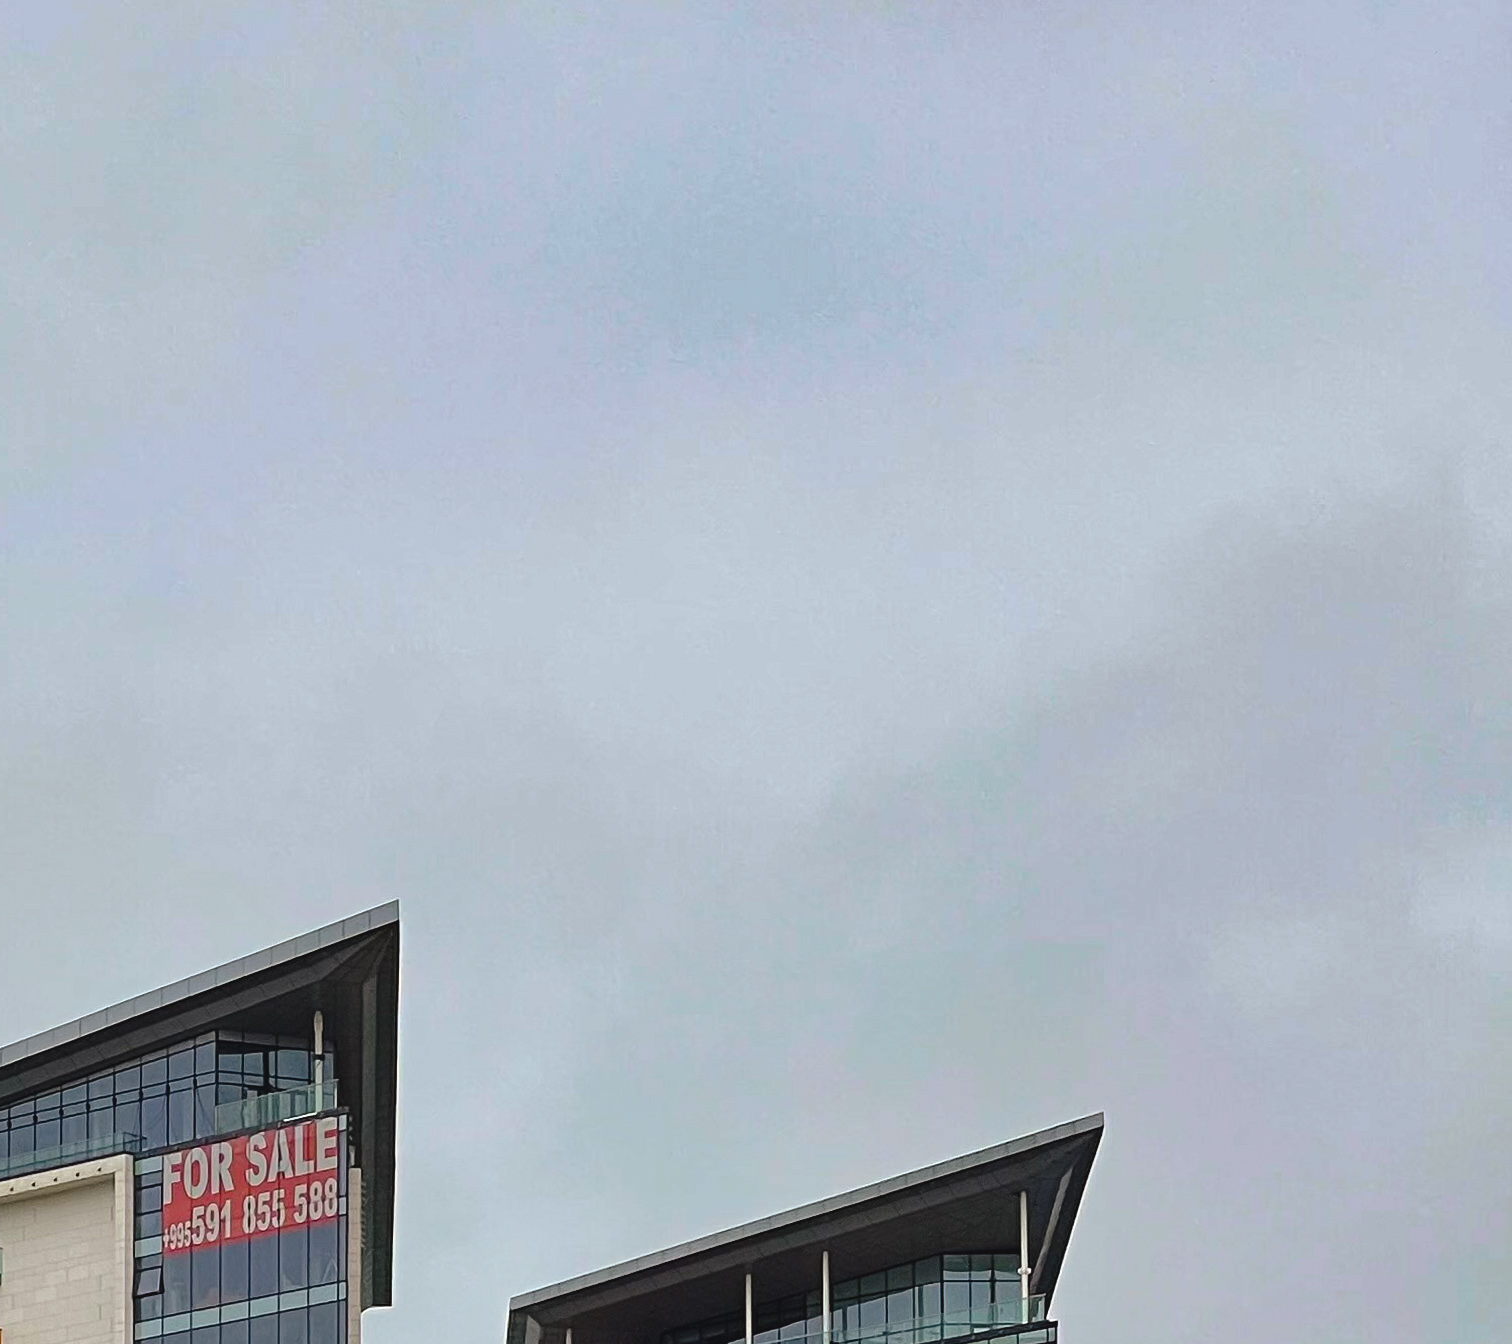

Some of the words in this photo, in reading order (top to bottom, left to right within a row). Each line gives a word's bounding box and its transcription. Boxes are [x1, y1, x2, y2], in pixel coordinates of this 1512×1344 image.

[163, 1142, 235, 1205] FOR
[245, 1116, 338, 1187] SALE
[242, 1189, 285, 1234] 855
[293, 1177, 337, 1223] 588
